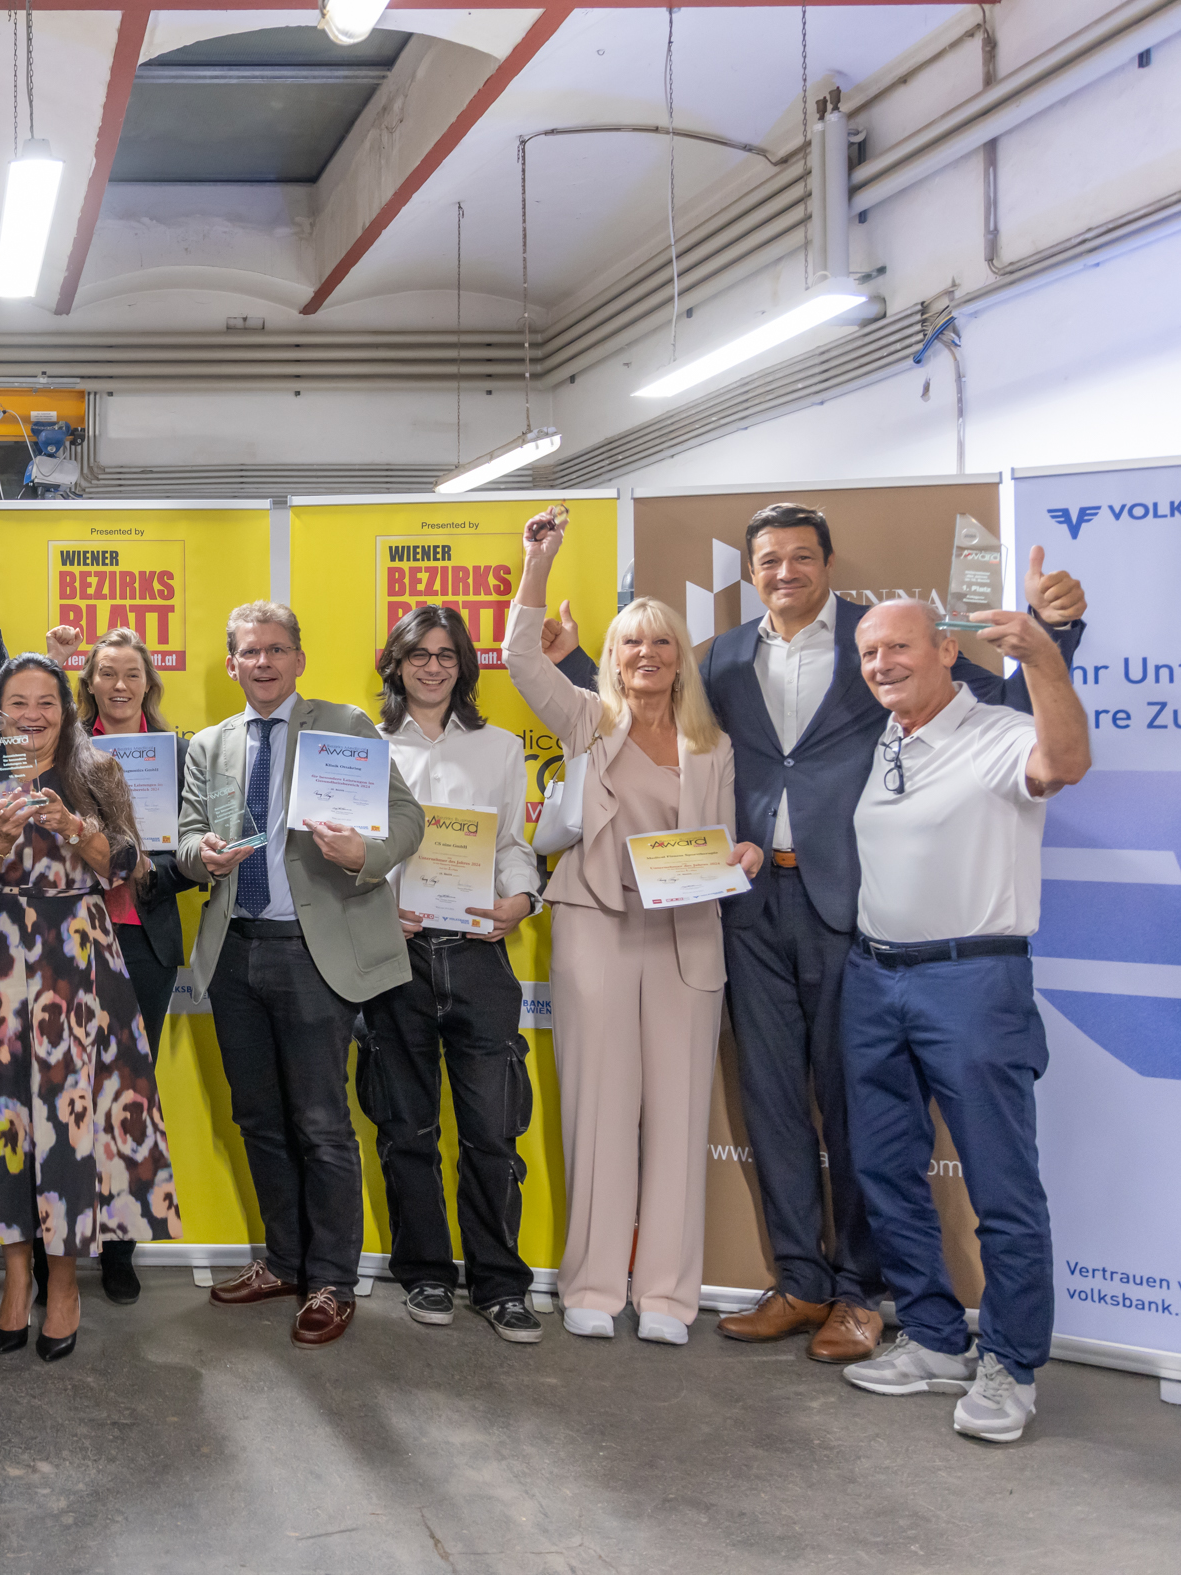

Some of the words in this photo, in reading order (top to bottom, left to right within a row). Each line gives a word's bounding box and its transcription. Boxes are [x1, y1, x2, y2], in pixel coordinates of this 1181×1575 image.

[1108, 500, 1181, 521] VOLK
[91, 528, 132, 536] Presented
[134, 528, 145, 537] by
[421, 521, 466, 530] Presented
[469, 520, 479, 530] by
[60, 550, 119, 567] WIENER
[389, 545, 452, 562] WIENER
[961, 550, 1000, 561] Award
[59, 570, 175, 600] BEZIRKS
[387, 564, 513, 597] BEZIRKS
[59, 604, 175, 645] BLATT
[1071, 657, 1110, 685] hr
[1124, 656, 1181, 685] Un
[0, 735, 29, 746] Award
[112, 747, 156, 760] Award
[319, 744, 368, 759] Award
[428, 815, 478, 833] Award
[652, 836, 707, 849] Award
[526, 1007, 552, 1015] WIEN
[1066, 1260, 1170, 1290] Vertrauen
